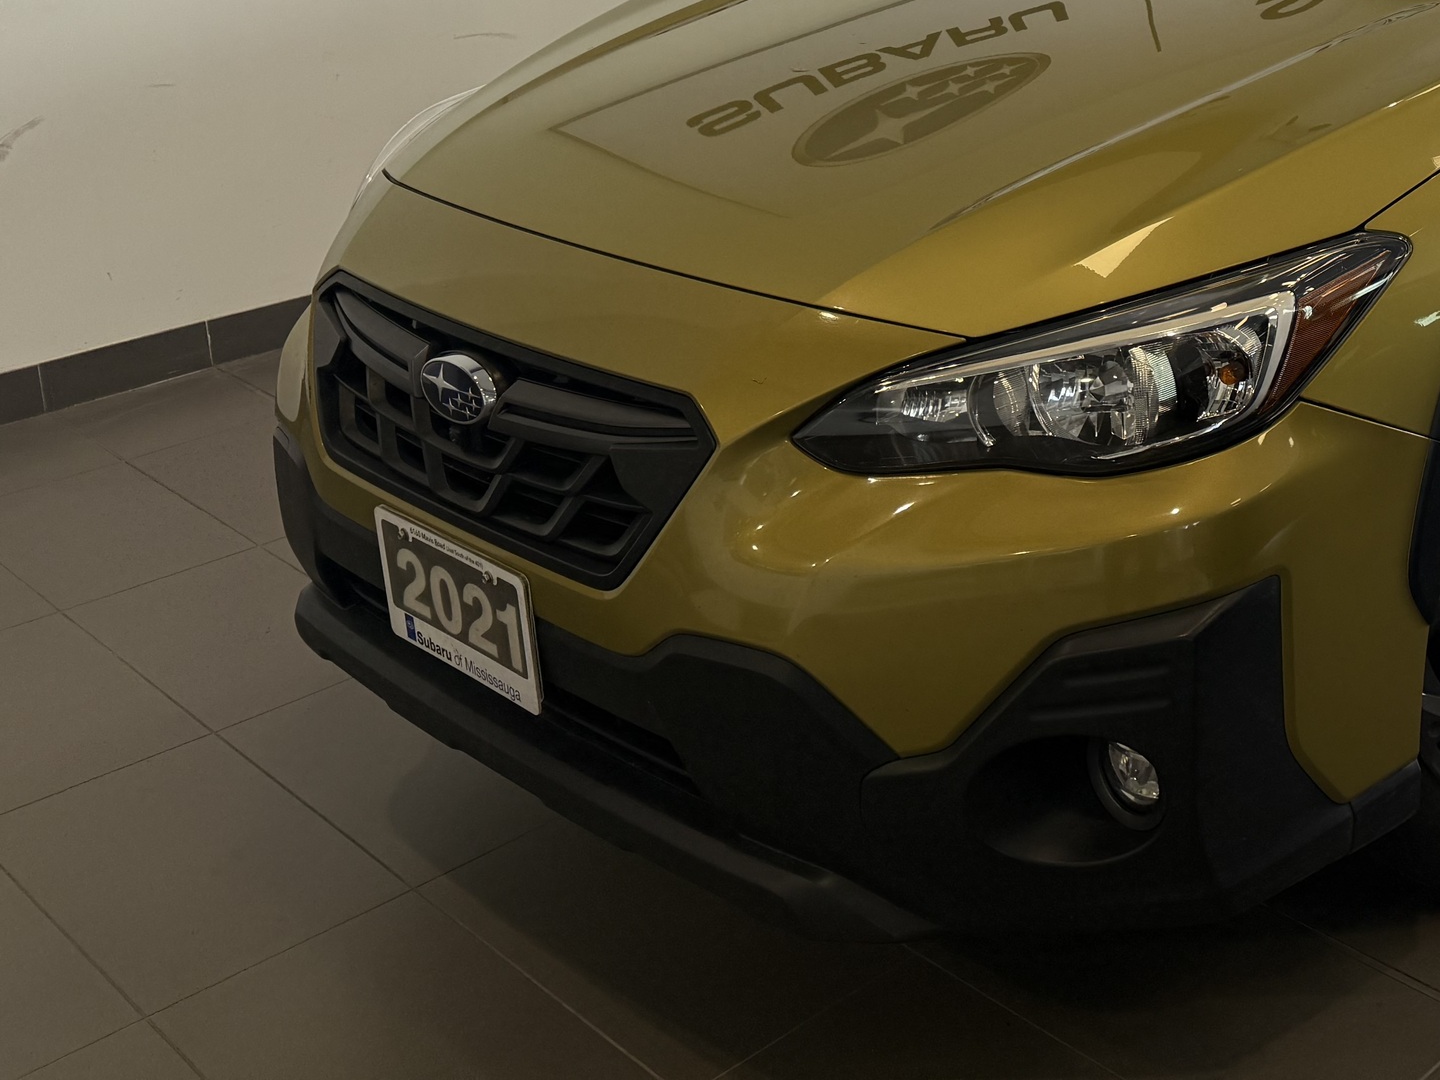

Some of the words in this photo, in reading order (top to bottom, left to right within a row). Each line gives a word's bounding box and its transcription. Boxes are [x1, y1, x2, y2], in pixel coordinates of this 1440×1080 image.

[396, 548, 523, 673] 2021
[416, 631, 452, 662] Subaru
[454, 654, 463, 667] of
[464, 657, 521, 702] Mississauga
